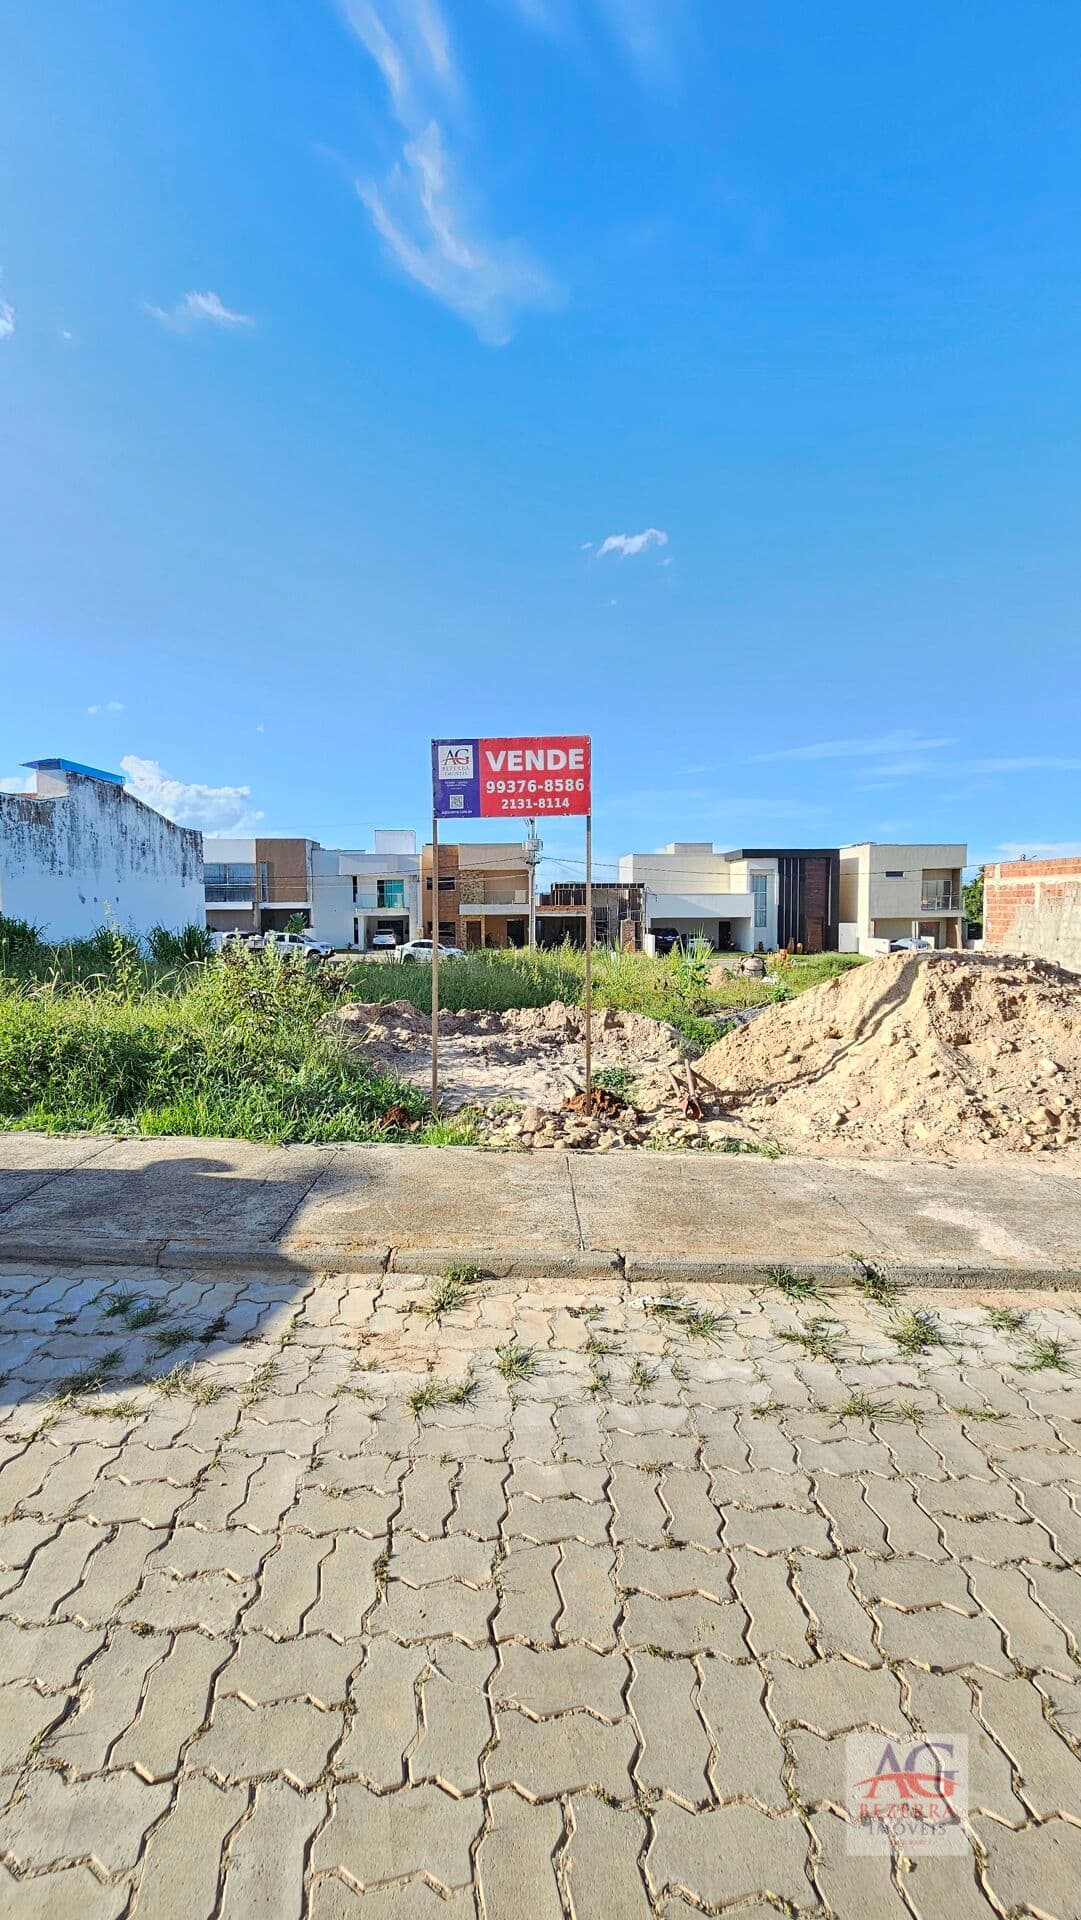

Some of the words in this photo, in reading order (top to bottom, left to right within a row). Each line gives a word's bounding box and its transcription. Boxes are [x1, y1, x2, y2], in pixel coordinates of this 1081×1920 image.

[443, 749, 469, 766] AG
[486, 749, 585, 772] VENDE
[486, 778, 585, 794] 99376-8586
[501, 797, 570, 810] 2131-8114
